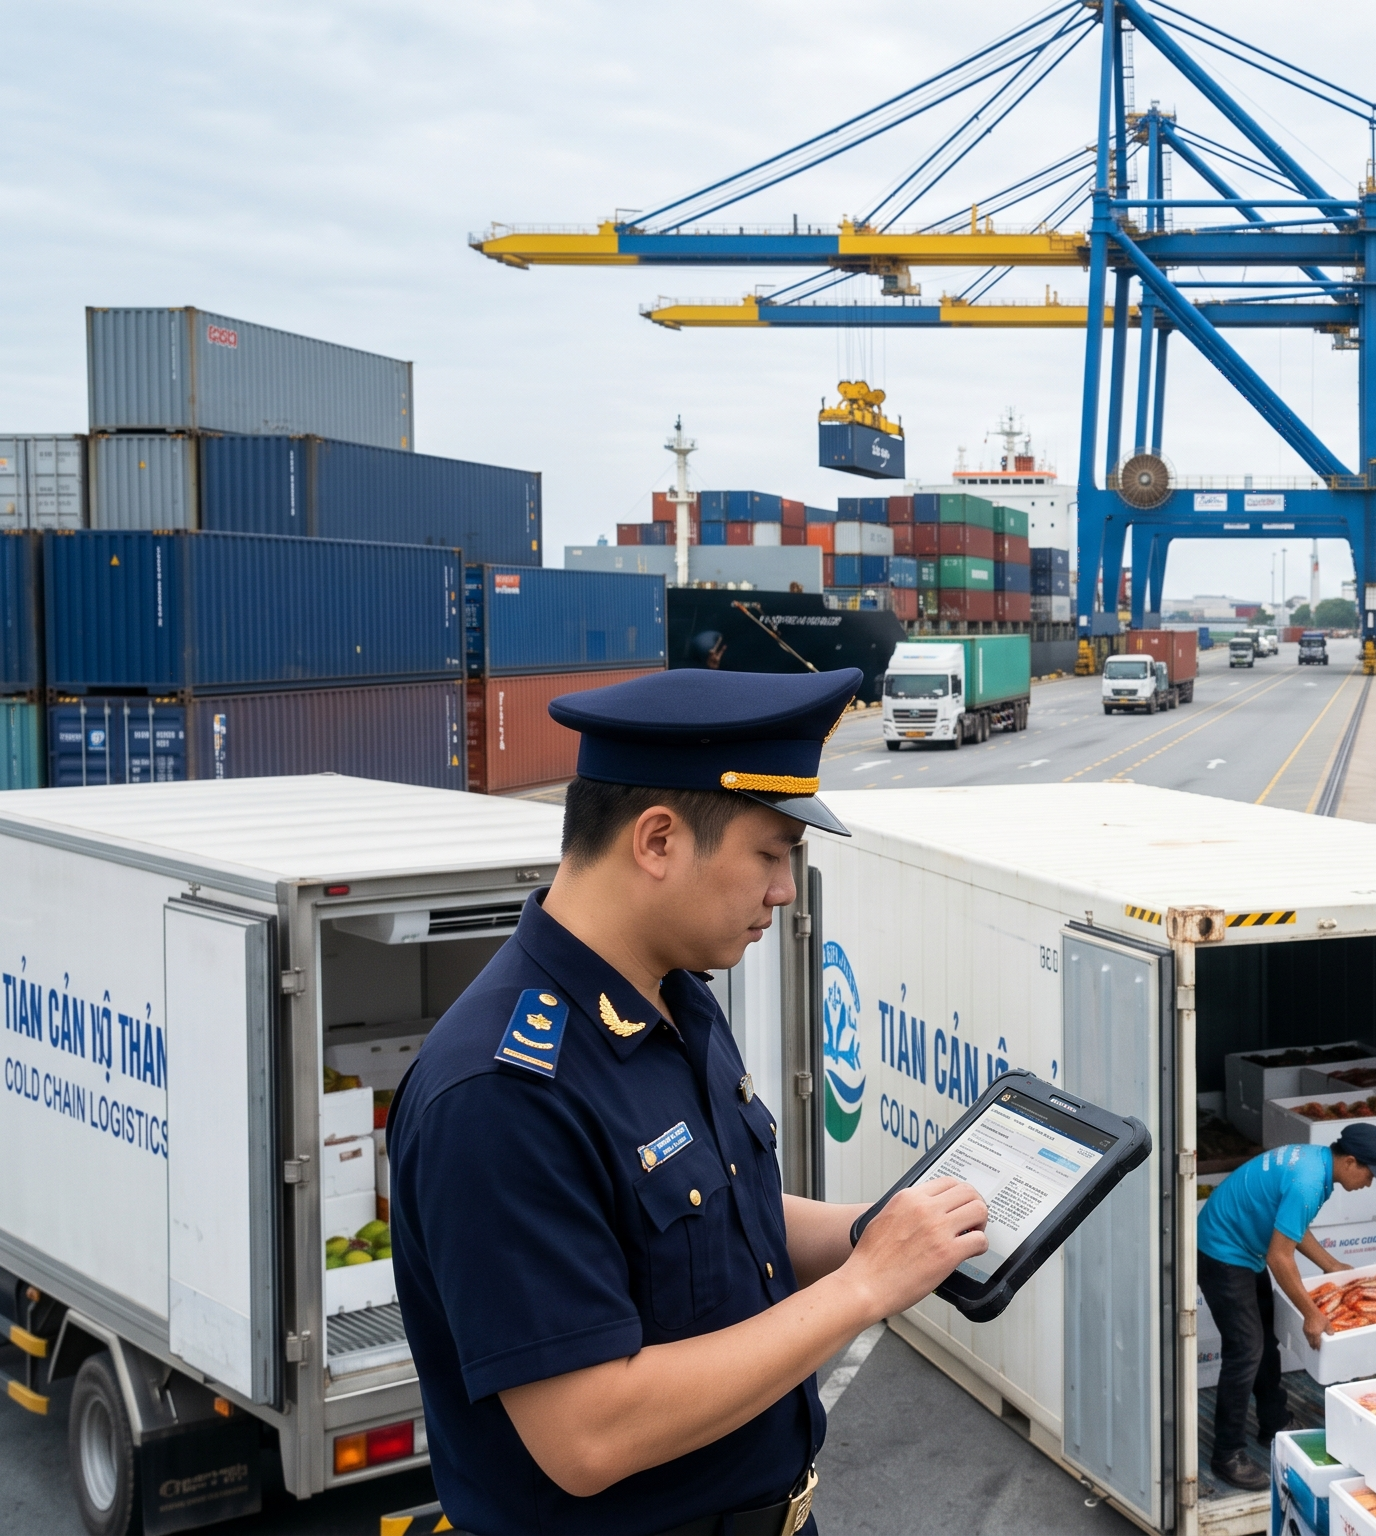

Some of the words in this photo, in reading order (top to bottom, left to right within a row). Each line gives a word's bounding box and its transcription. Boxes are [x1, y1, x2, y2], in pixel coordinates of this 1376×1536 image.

[5, 1056, 40, 1102] COLD
[43, 1072, 86, 1123] CHAIN
[90, 1091, 167, 1159] LOGISTICS
[880, 1093, 920, 1150] COLD
